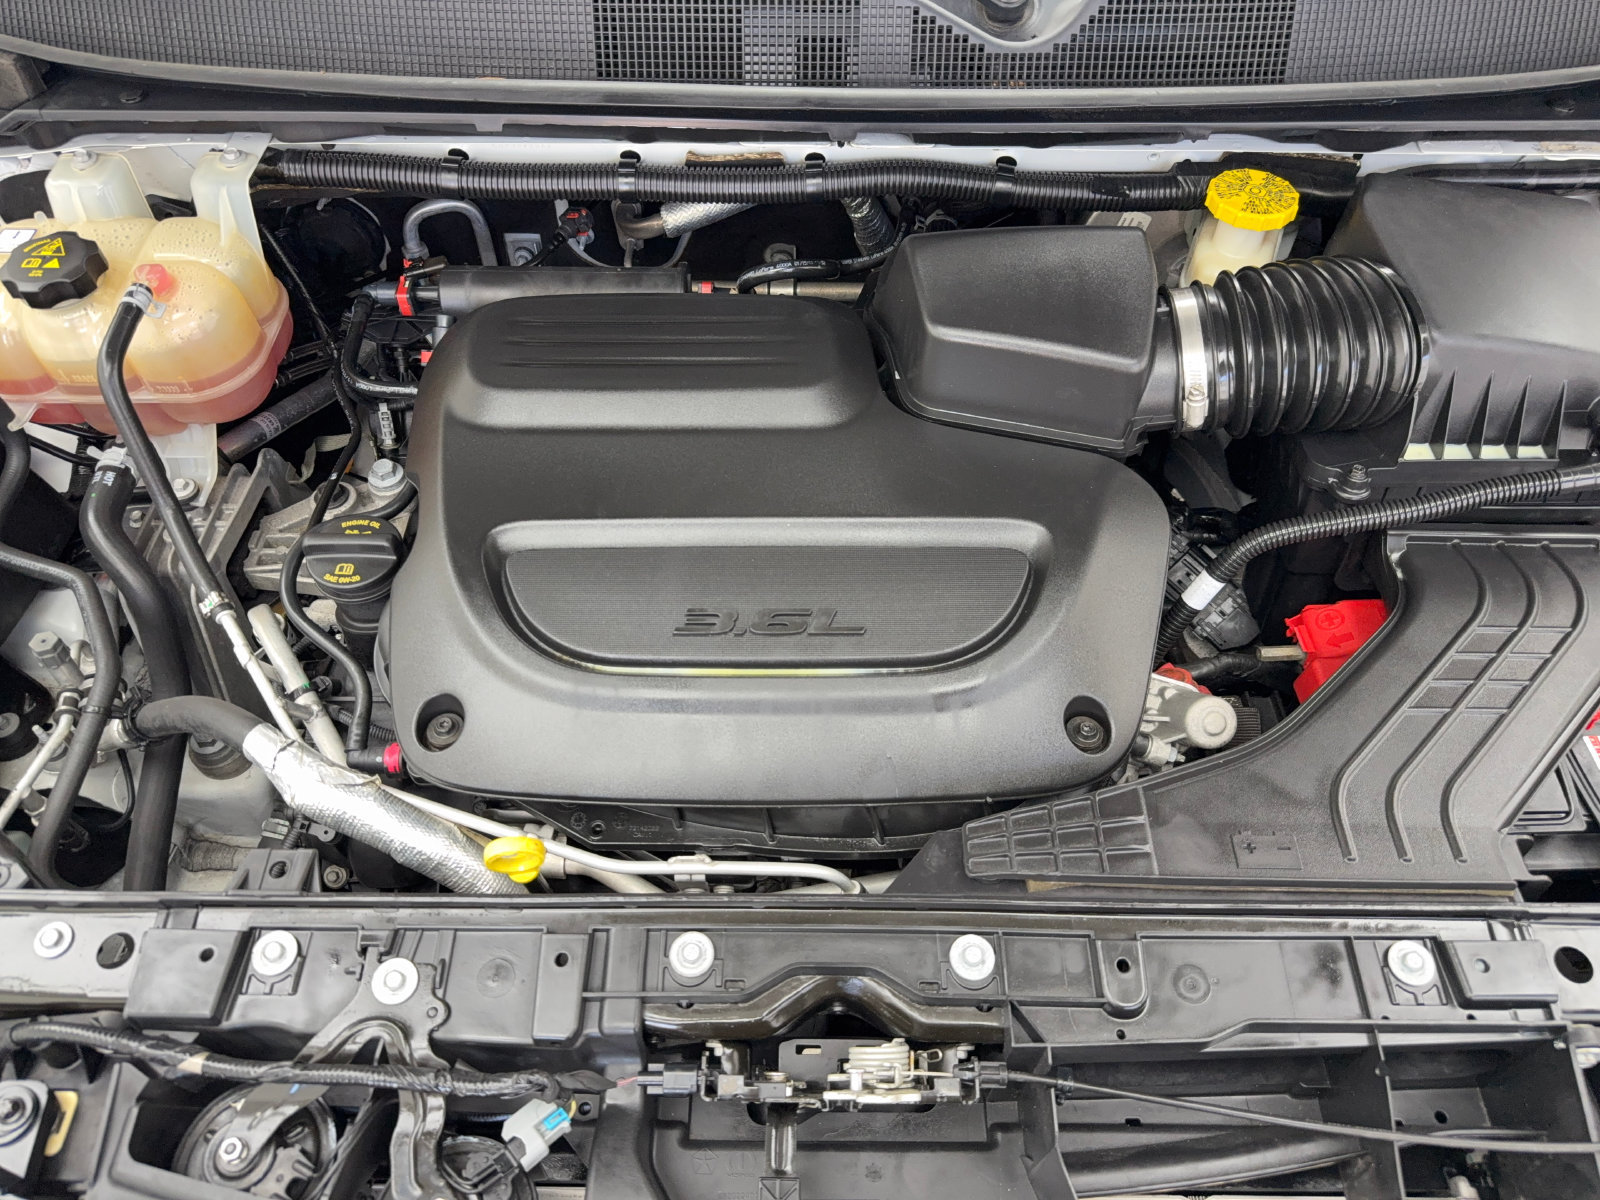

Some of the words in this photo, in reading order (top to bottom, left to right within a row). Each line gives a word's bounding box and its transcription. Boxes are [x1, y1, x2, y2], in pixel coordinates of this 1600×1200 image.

[102, 471, 117, 487] HOT
[370, 521, 381, 529] OIL
[323, 573, 338, 583] SAE
[338, 575, 361, 583] 0W-20
[672, 607, 868, 637] 3.6L
